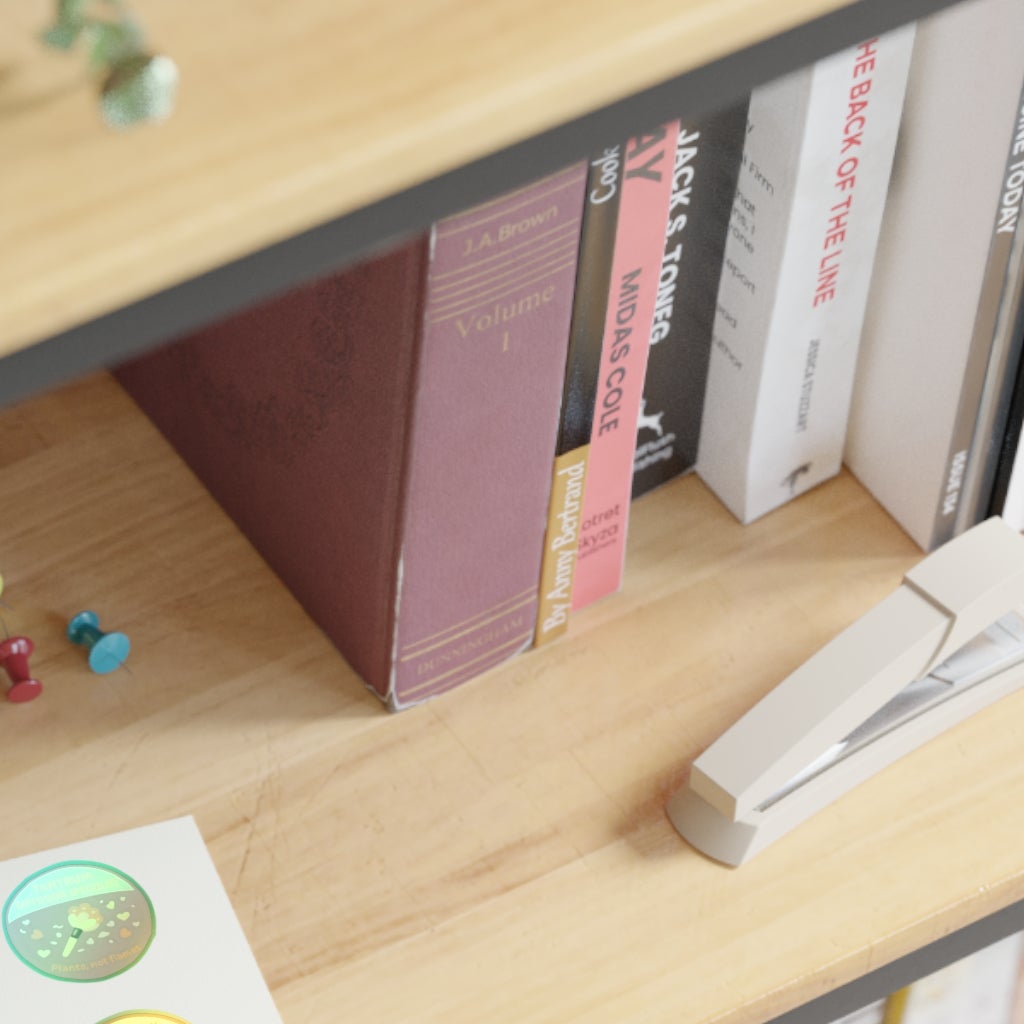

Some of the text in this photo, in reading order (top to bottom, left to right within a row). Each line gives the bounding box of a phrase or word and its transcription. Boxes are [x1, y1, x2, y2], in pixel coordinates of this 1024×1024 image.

[841, 78, 872, 154] BACK
[589, 144, 621, 204] Cook
[670, 128, 701, 211] JACK
[834, 156, 859, 191] OF
[997, 159, 1024, 234] TODAY
[823, 194, 853, 250] THE
[812, 249, 842, 308] LINE
[455, 284, 557, 338] Volume
[597, 267, 642, 437] MIDAS COLE
[551, 460, 585, 551] Bertrand
[542, 602, 572, 635] By
